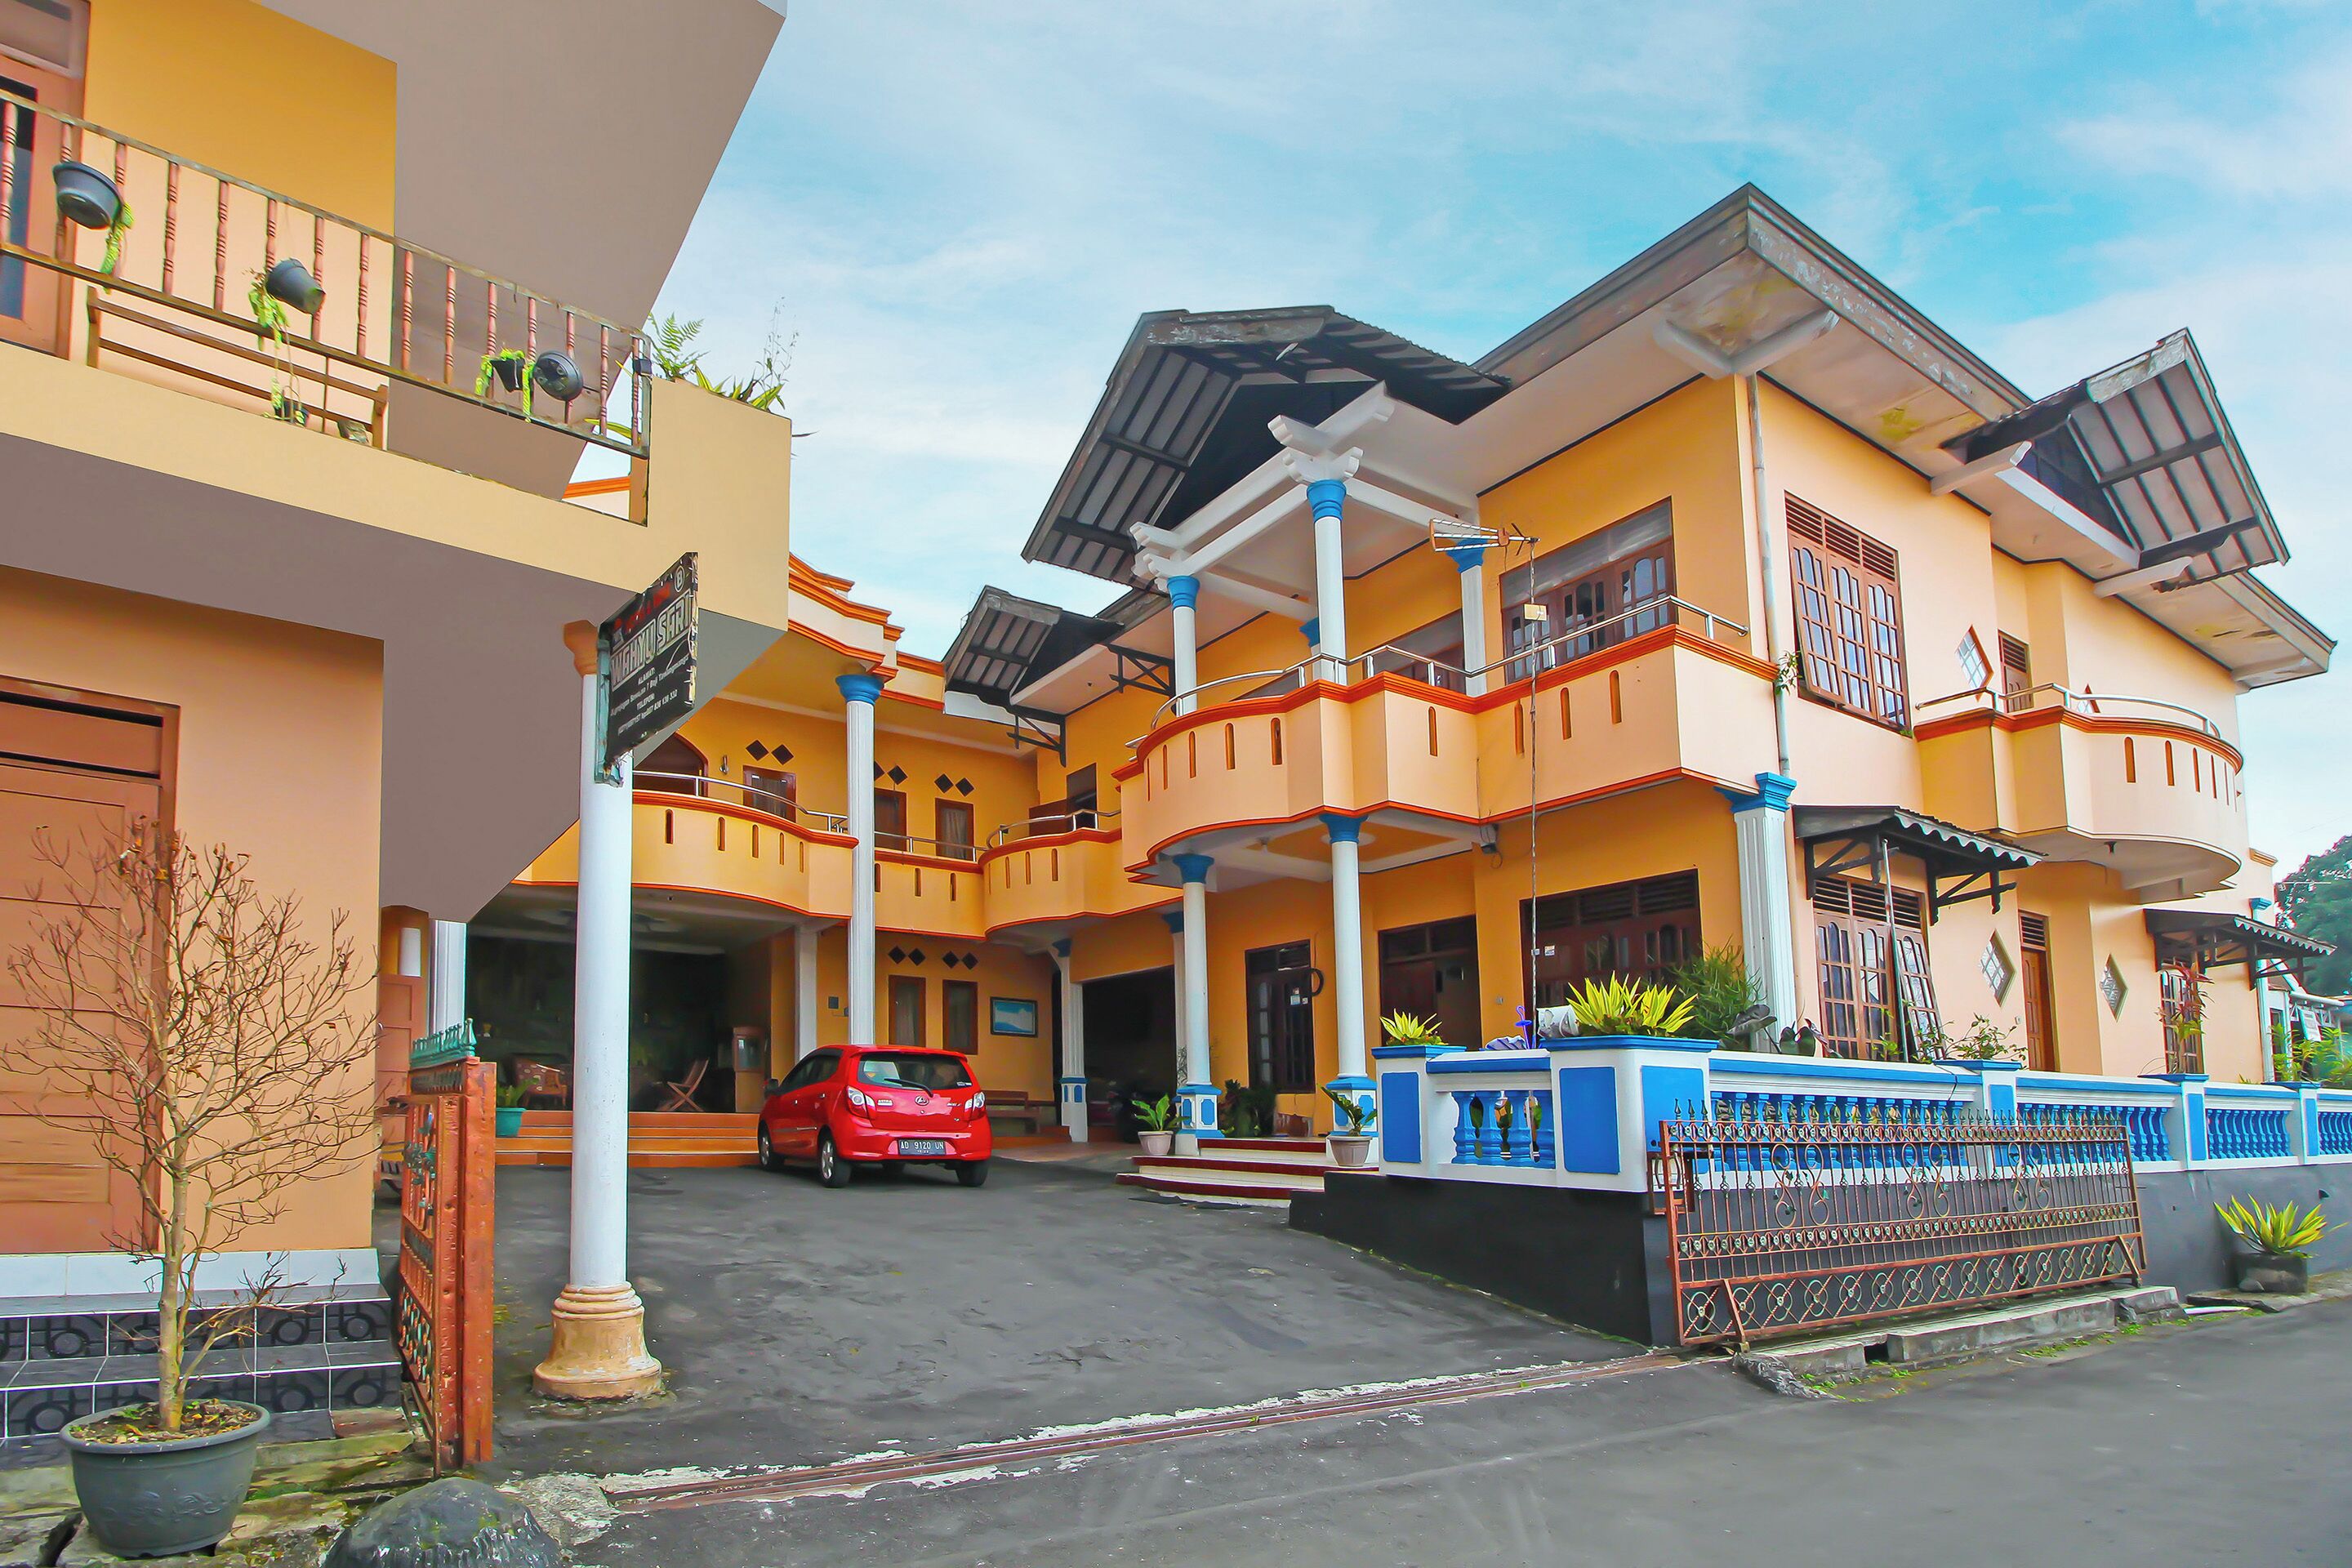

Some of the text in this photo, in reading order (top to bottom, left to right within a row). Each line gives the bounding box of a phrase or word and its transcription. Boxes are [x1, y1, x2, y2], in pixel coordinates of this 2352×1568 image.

[612, 620, 656, 689] WAHYU
[657, 591, 690, 653] SARI
[914, 1141, 931, 1150] 9120
